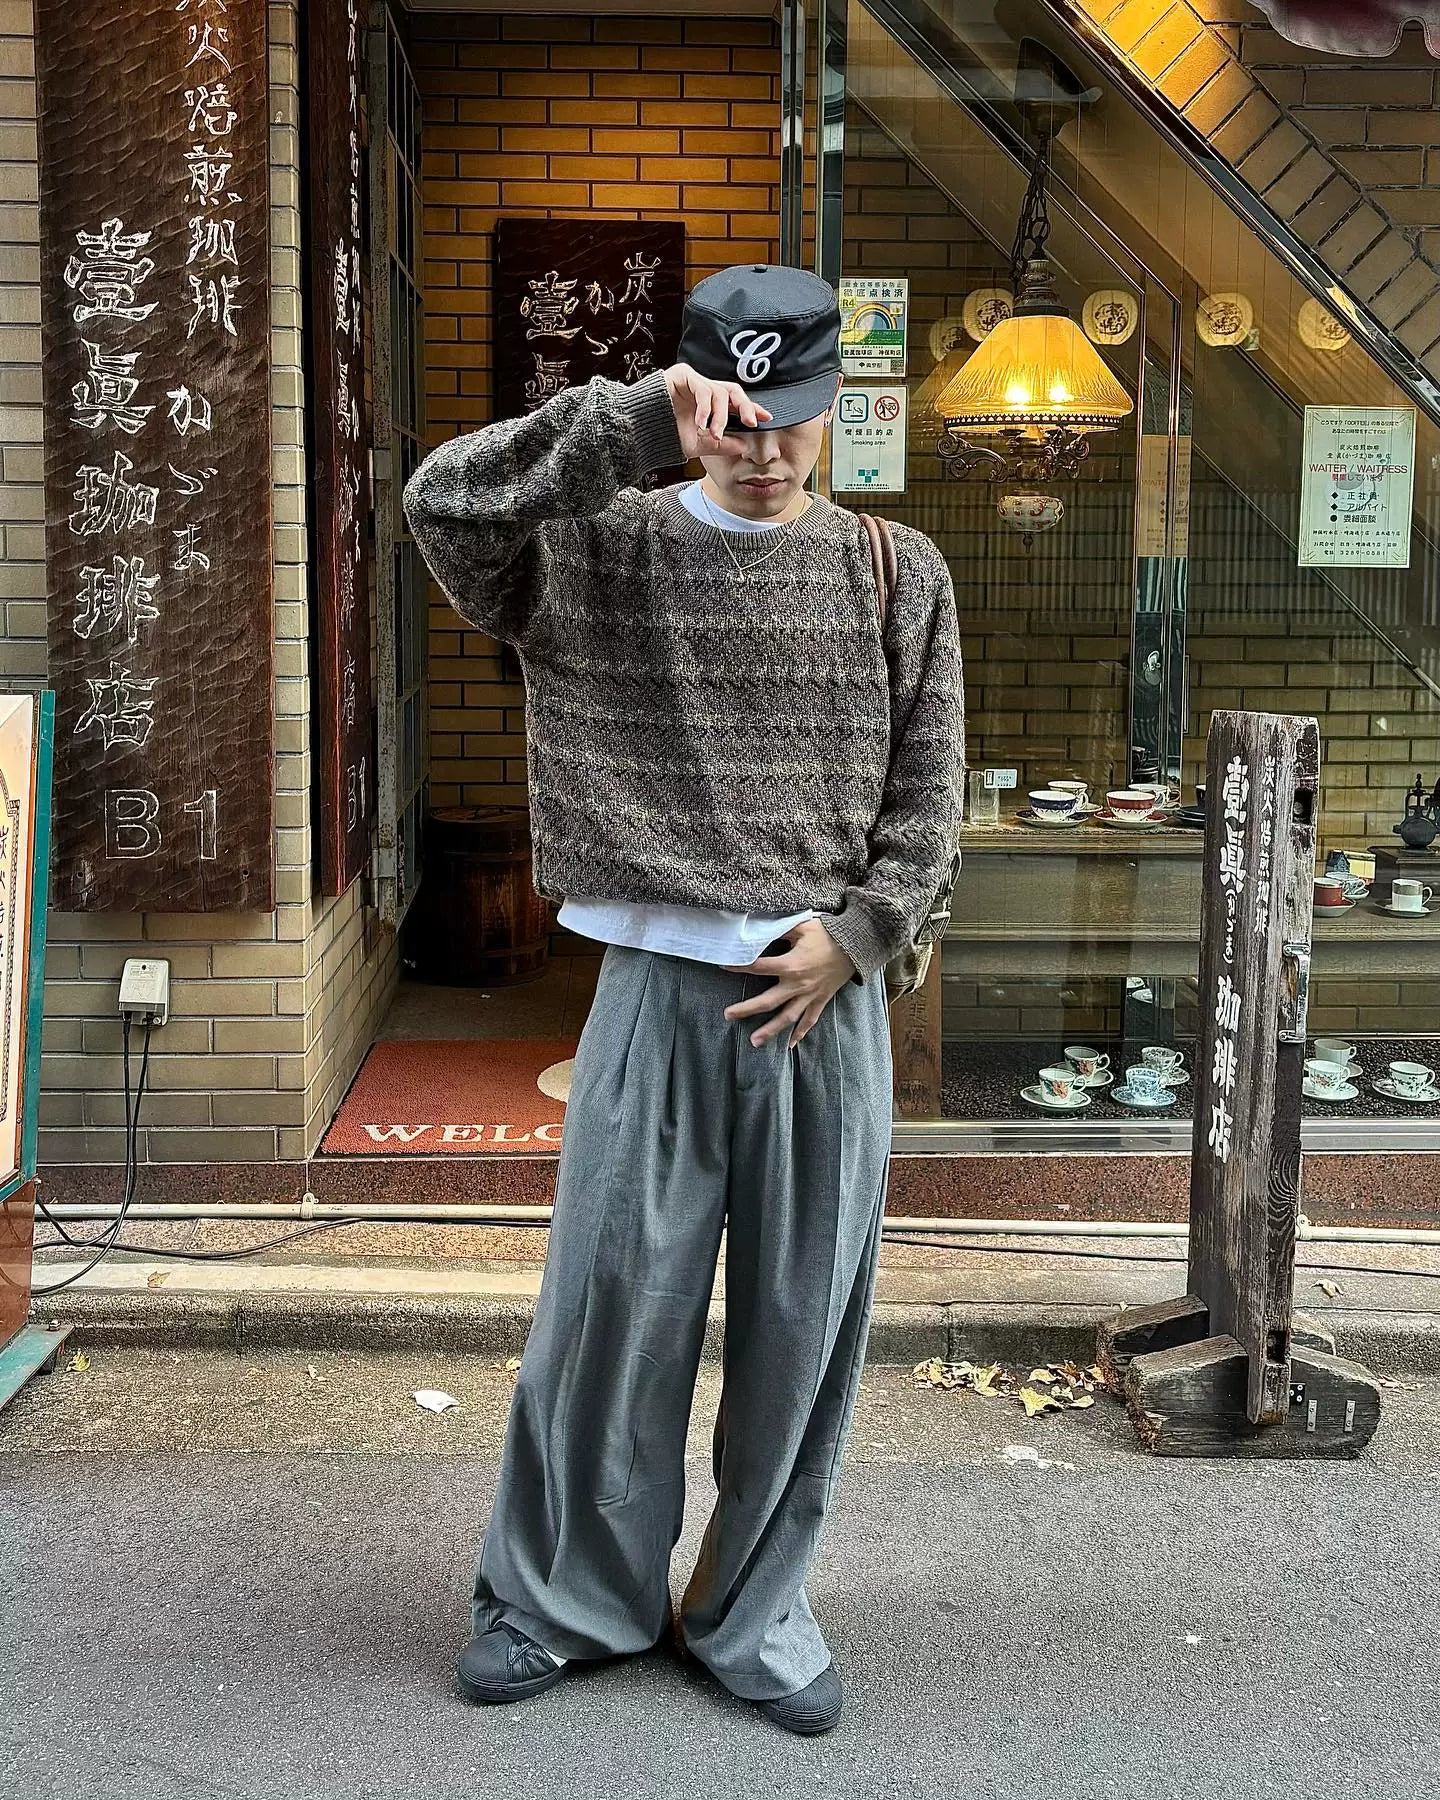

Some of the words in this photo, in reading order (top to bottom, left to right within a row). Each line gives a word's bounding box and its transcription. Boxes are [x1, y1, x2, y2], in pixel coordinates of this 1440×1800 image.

[174, 0, 243, 339] 火焙煎珈琲
[842, 299, 856, 307] R4
[1308, 464, 1347, 473] WAITER
[1356, 465, 1408, 474] WAITRESS
[166, 383, 218, 570] かづま
[1347, 491, 1378, 500] 正社員
[1348, 503, 1388, 512] アルバイト
[105, 789, 218, 860] B1
